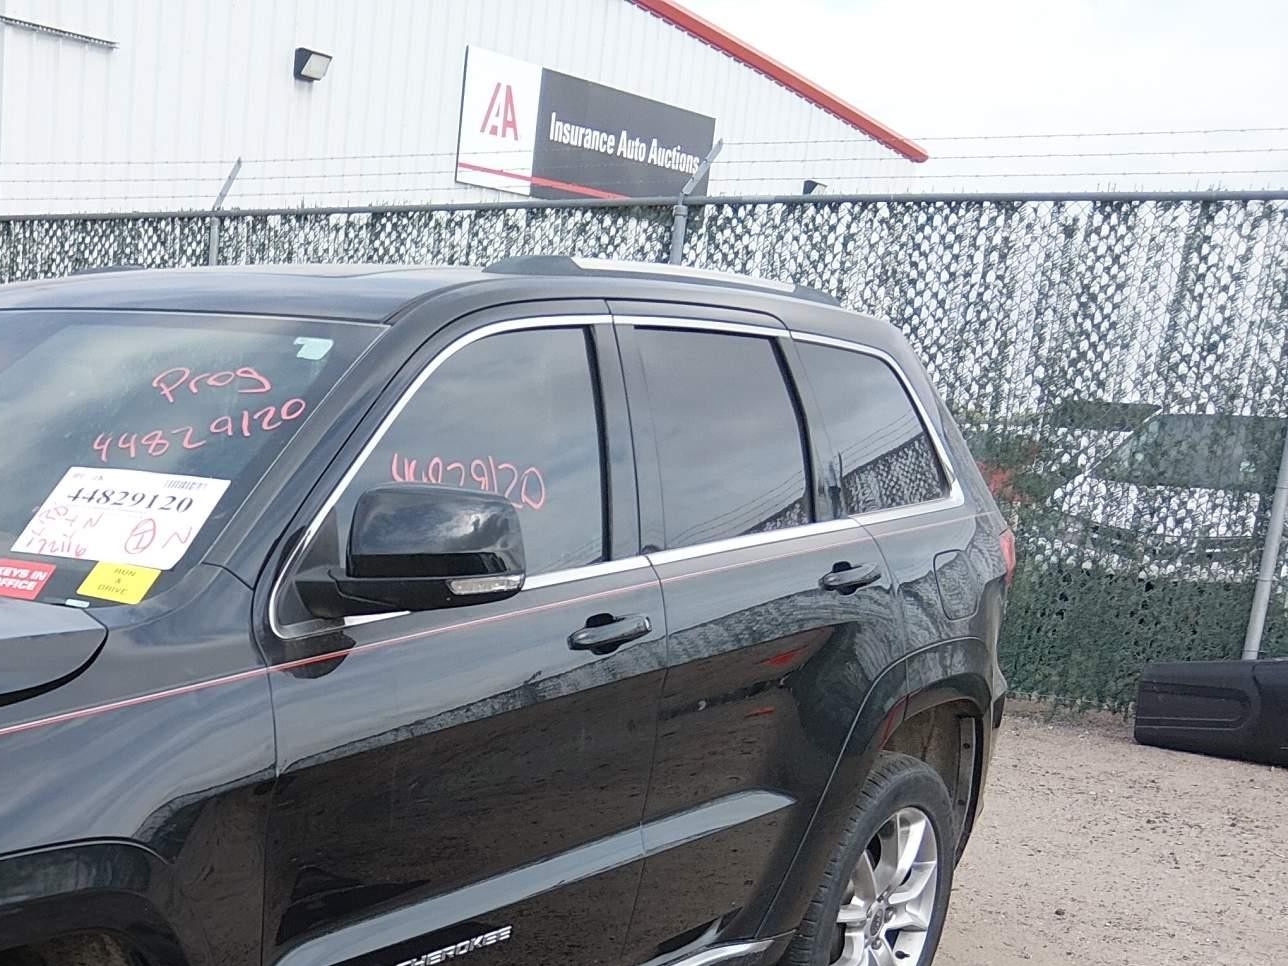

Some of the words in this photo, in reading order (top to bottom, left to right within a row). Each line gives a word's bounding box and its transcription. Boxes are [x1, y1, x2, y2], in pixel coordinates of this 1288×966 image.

[549, 112, 616, 155] Insurance
[616, 130, 647, 162] Auto
[647, 140, 700, 175] Auctions
[152, 366, 272, 403] Prog
[67, 487, 195, 513] 44829120
[31, 570, 47, 582] IN
[97, 584, 129, 595] DRIVE
